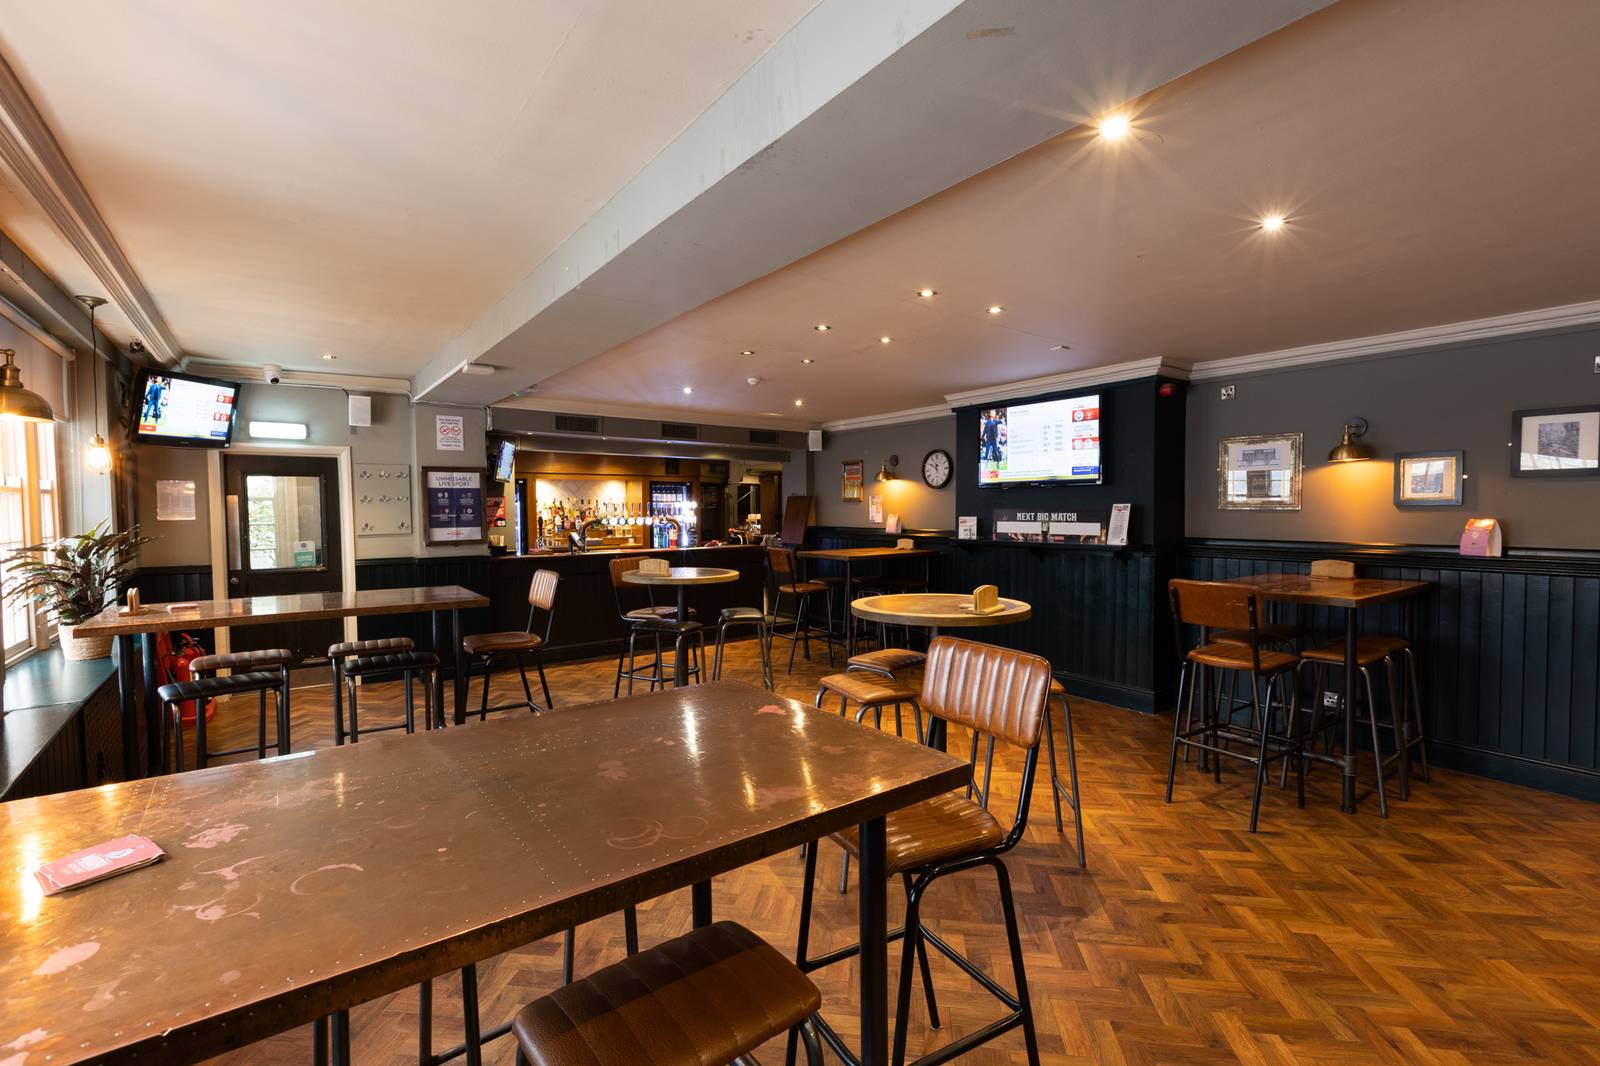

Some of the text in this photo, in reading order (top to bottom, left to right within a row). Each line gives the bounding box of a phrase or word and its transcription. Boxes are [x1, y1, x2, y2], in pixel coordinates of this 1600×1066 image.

[1016, 512, 1077, 521] NEXT BIG MATCH
